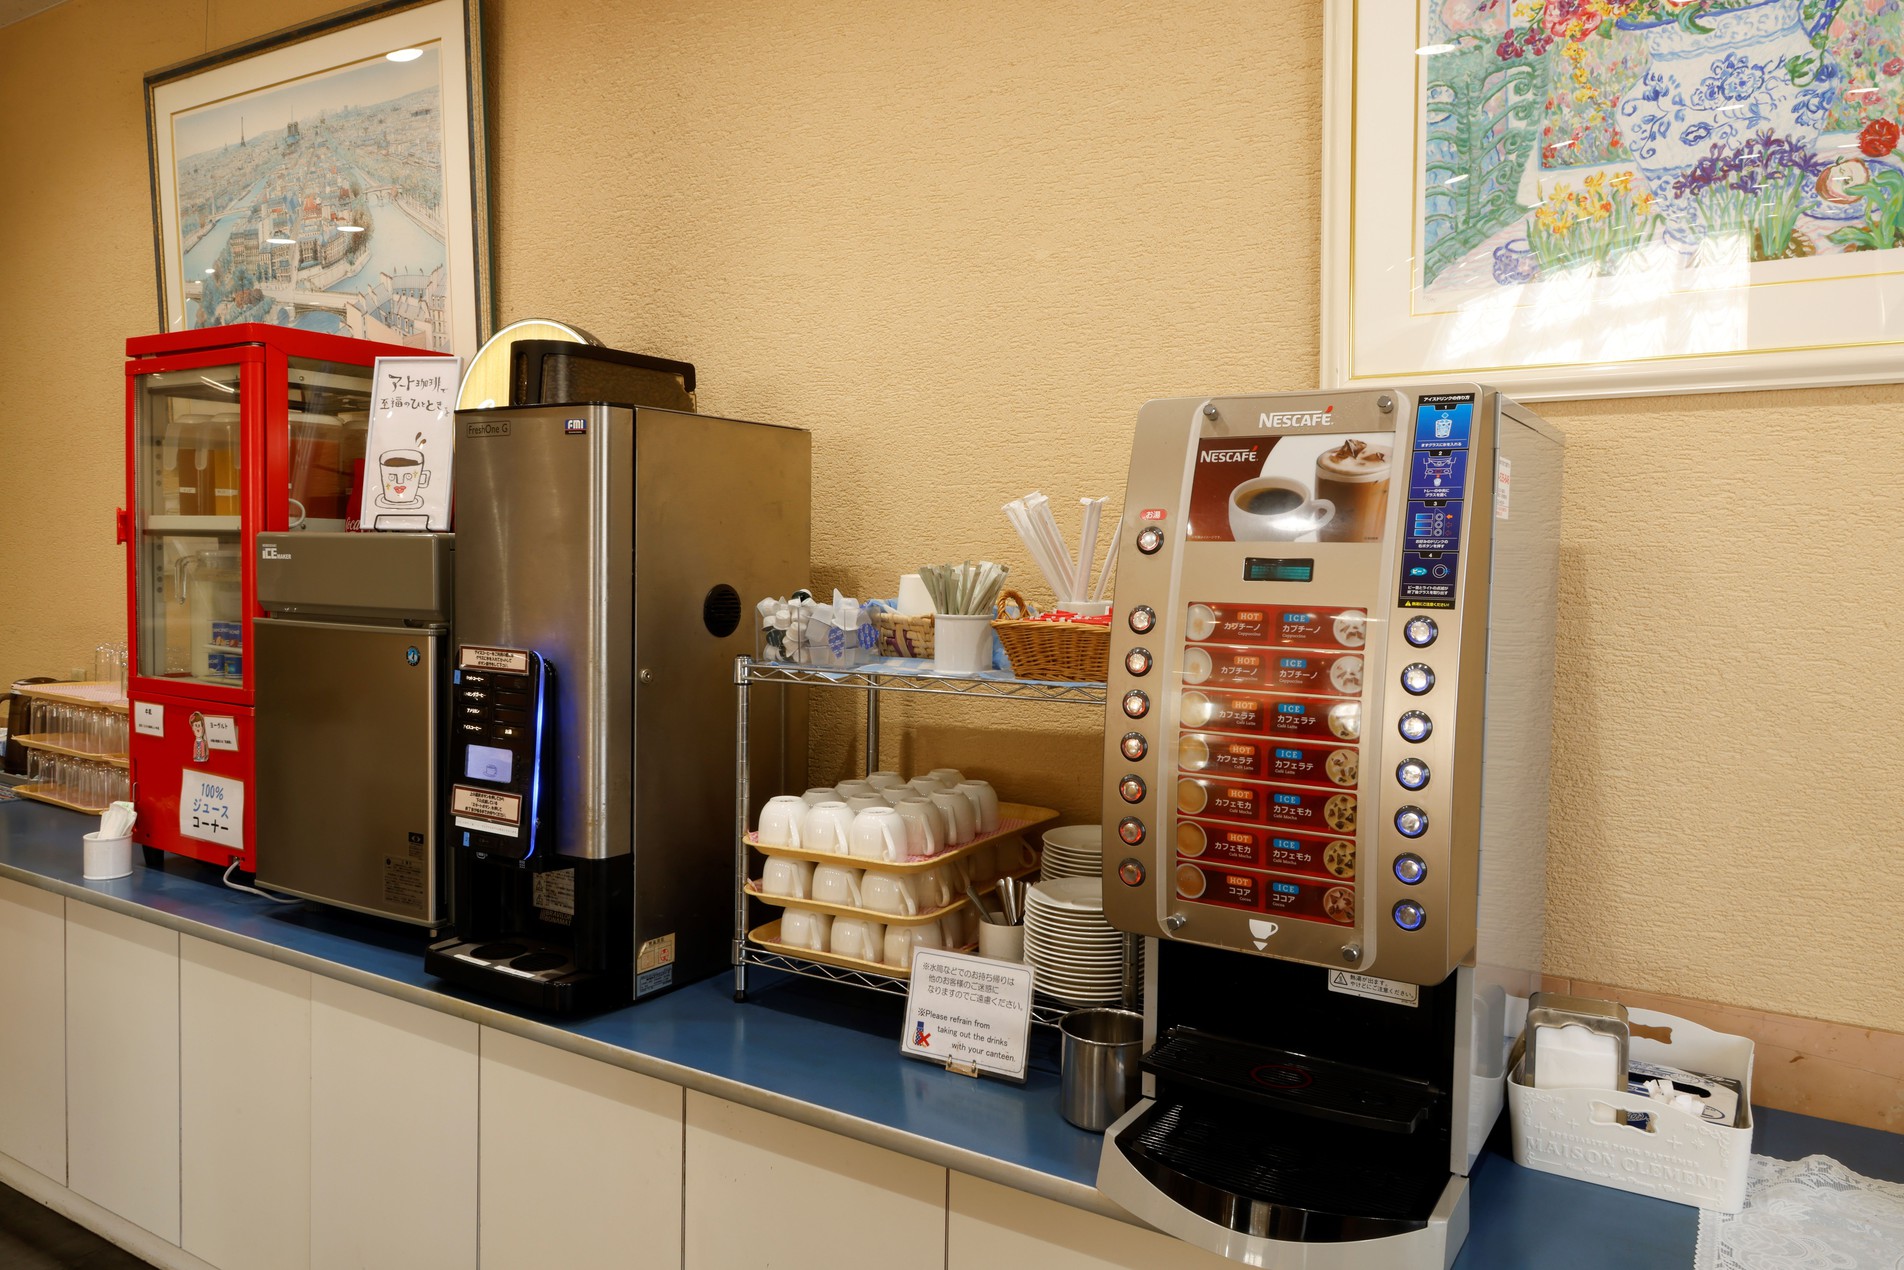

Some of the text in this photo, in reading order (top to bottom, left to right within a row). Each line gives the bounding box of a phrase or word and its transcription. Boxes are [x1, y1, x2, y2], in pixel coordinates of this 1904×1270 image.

[1258, 405, 1334, 428] NESCAFÉ
[468, 423, 508, 435] FreshOne G
[1200, 445, 1258, 463] NESCAFÉ
[1240, 612, 1259, 620] HOT
[1288, 614, 1305, 622] ICE
[1282, 624, 1321, 633] カプチーノ
[1285, 659, 1302, 667] ICE
[1221, 666, 1258, 676] カプチーノ
[1279, 670, 1318, 679] カプチーノ
[1235, 701, 1254, 709] HOT
[1283, 704, 1300, 712] ICE
[1219, 710, 1256, 720] カフェラテ
[1277, 715, 1316, 725] カフェラテ
[1232, 746, 1252, 754] HOT
[1281, 750, 1298, 758] ICE
[1217, 755, 1253, 764] カフェラテ
[1275, 760, 1314, 770] カフェラテ
[201, 783, 224, 800] 100%
[1231, 790, 1250, 798] HOT
[1215, 799, 1252, 809] カフェモカ
[1279, 795, 1296, 803] ICE
[193, 798, 229, 819] ジュース
[1273, 805, 1312, 816] カフェモカ
[193, 816, 229, 833] コーナー
[1230, 834, 1249, 842] HOT
[1214, 842, 1251, 853] カフェモカ
[1278, 840, 1295, 848] ICE
[1273, 850, 1312, 861] カフェモカ
[1229, 876, 1249, 885] HOT
[1228, 887, 1250, 896] ココア
[1278, 884, 1295, 892] ICE
[1273, 894, 1295, 903] ココア
[928, 974, 1000, 995] 他のお客様のご迷惑に
[949, 1016, 972, 1026] refrain
[974, 1019, 991, 1030] from
[937, 1026, 1008, 1047] taking out the drinks
[951, 1041, 1016, 1063] with your canteen.
[1526, 1135, 1615, 1169] MAISON
